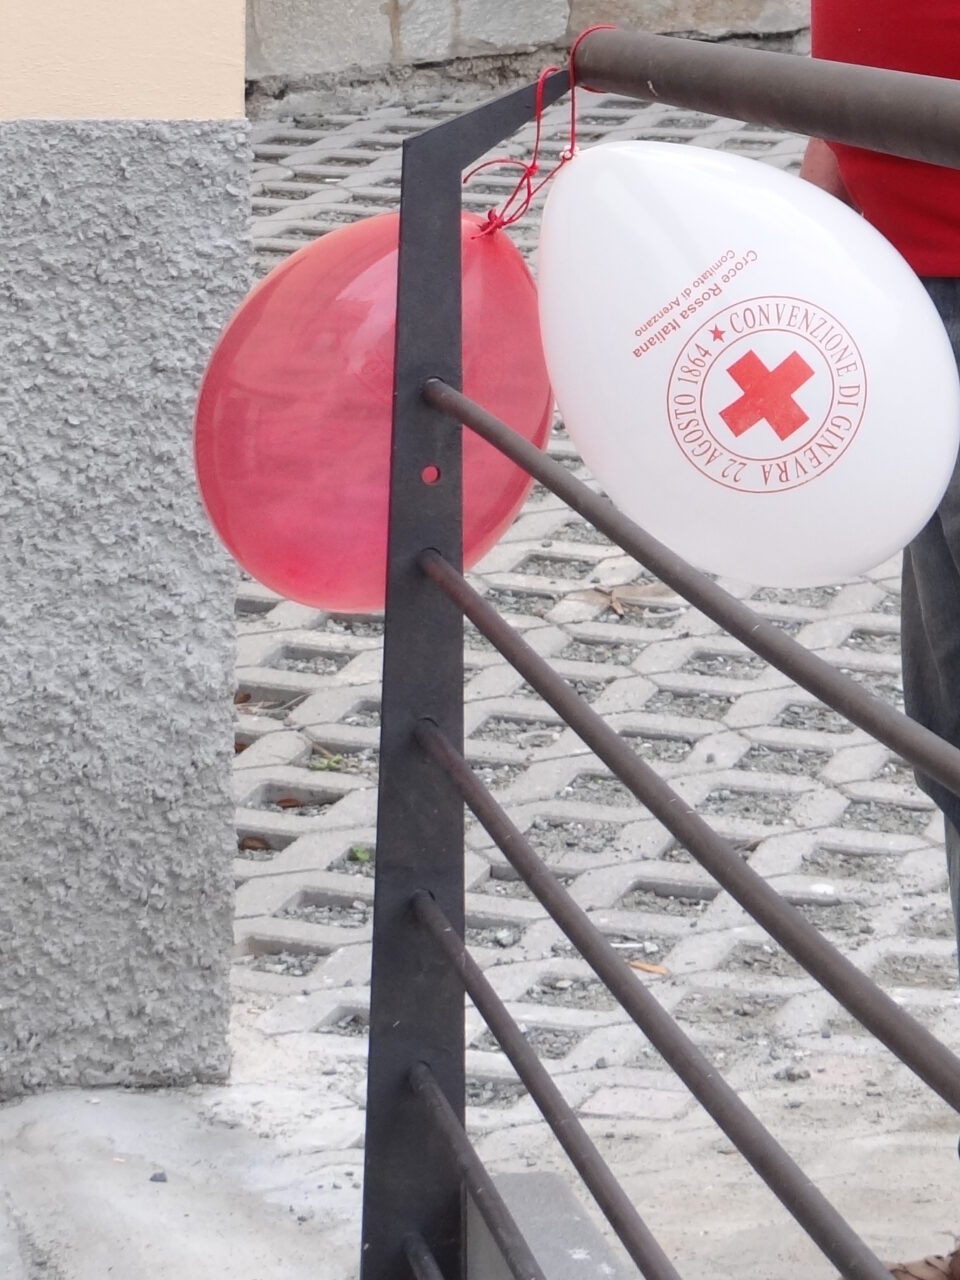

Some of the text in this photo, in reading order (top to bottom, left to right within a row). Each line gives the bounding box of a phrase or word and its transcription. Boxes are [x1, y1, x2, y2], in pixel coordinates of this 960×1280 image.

[632, 249, 758, 358] Croce Rossa Italiana
[634, 249, 736, 337] Comitato di Arenzano
[673, 343, 747, 483] 22 AGOSTO 1864
[729, 303, 860, 486] CONVENZIONE DI GINEVRA
